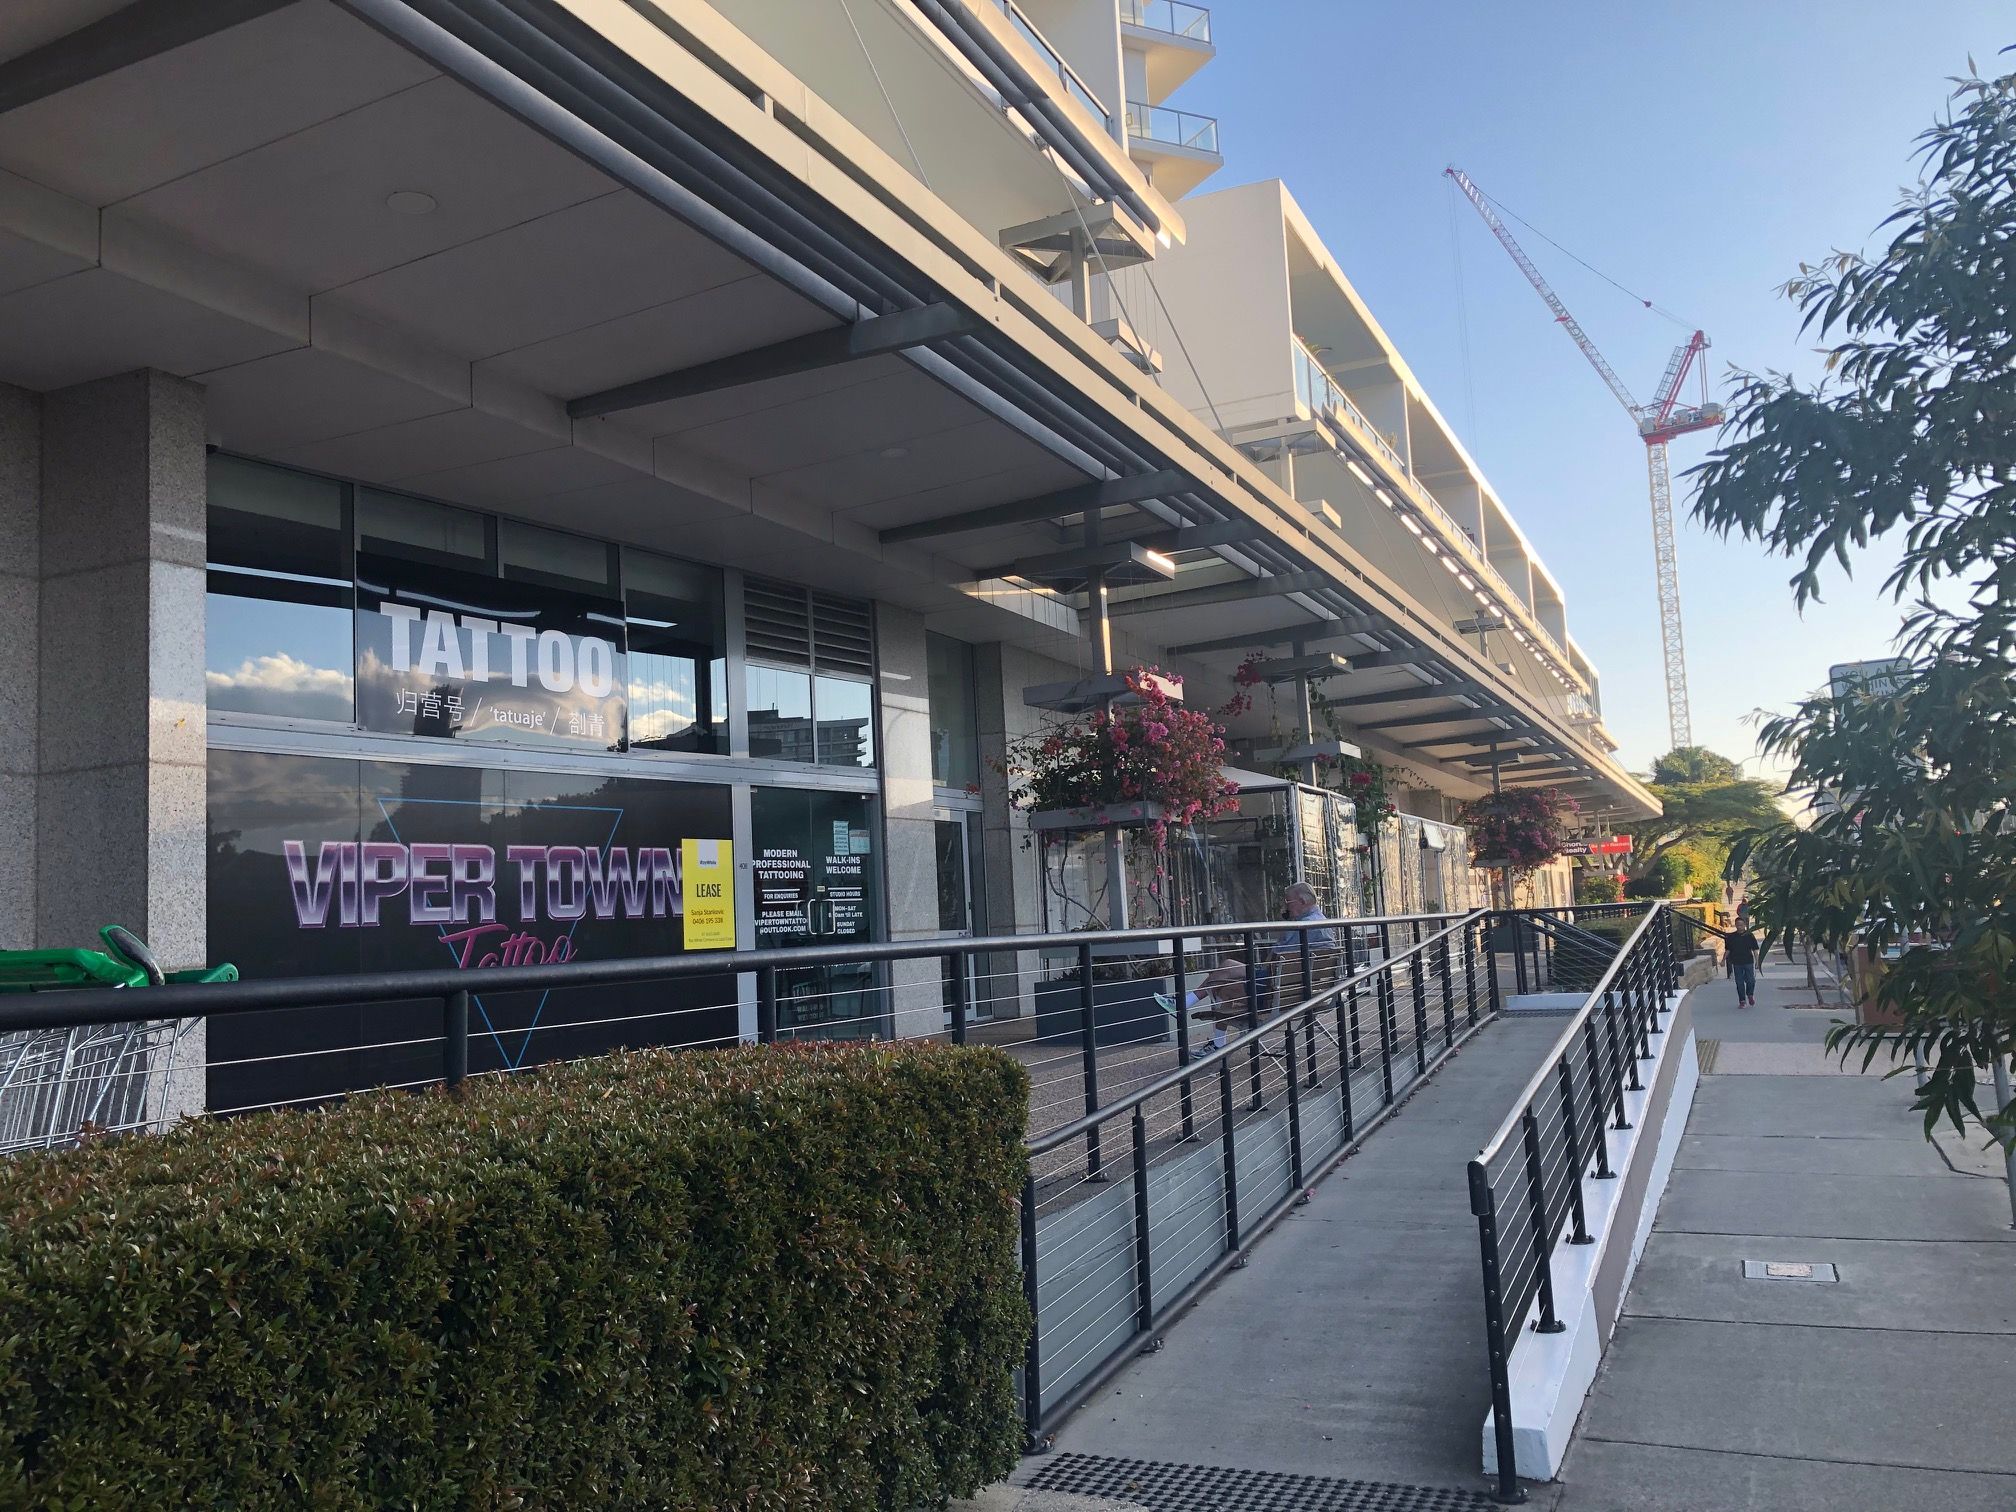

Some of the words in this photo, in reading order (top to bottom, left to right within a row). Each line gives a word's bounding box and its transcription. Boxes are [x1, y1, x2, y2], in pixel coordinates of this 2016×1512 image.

[380, 602, 612, 697] TATTOO
[763, 849, 798, 858] MODERN
[825, 855, 861, 864] WALK-INS
[752, 860, 811, 869] PROFESSIONAL
[758, 870, 804, 879] TATTOOING
[825, 866, 862, 875] WELCOME
[283, 840, 496, 928] VIPER
[507, 845, 683, 922] TOWN
[696, 883, 722, 898] LEASE
[774, 892, 799, 900] ENQUIRIES
[762, 910, 785, 918] PLEASE
[785, 910, 803, 918] EMAIL
[760, 925, 807, 935] @OUTLOOK.COM
